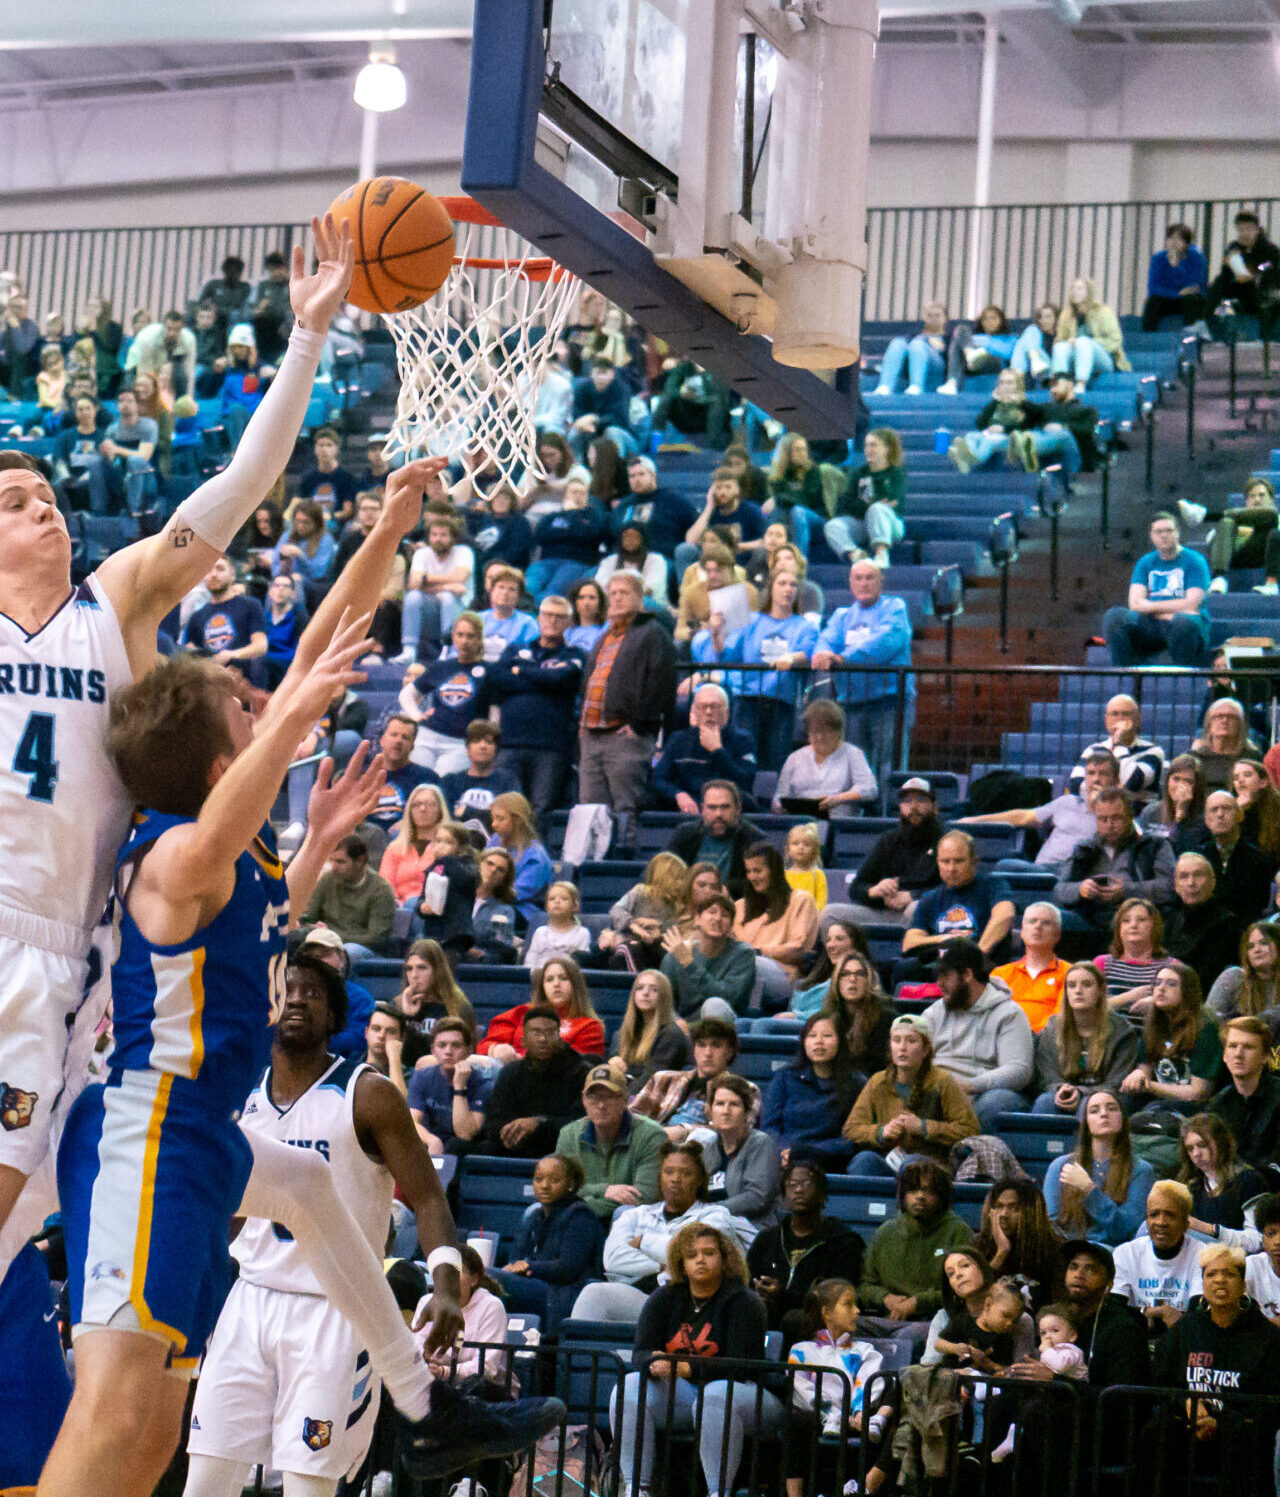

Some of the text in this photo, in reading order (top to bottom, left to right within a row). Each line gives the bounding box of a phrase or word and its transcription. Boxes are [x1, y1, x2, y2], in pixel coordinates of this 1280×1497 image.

[11, 710, 60, 804] 4
[1187, 1352, 1214, 1367] RED
[1186, 1366, 1241, 1388] LIPSTICK
